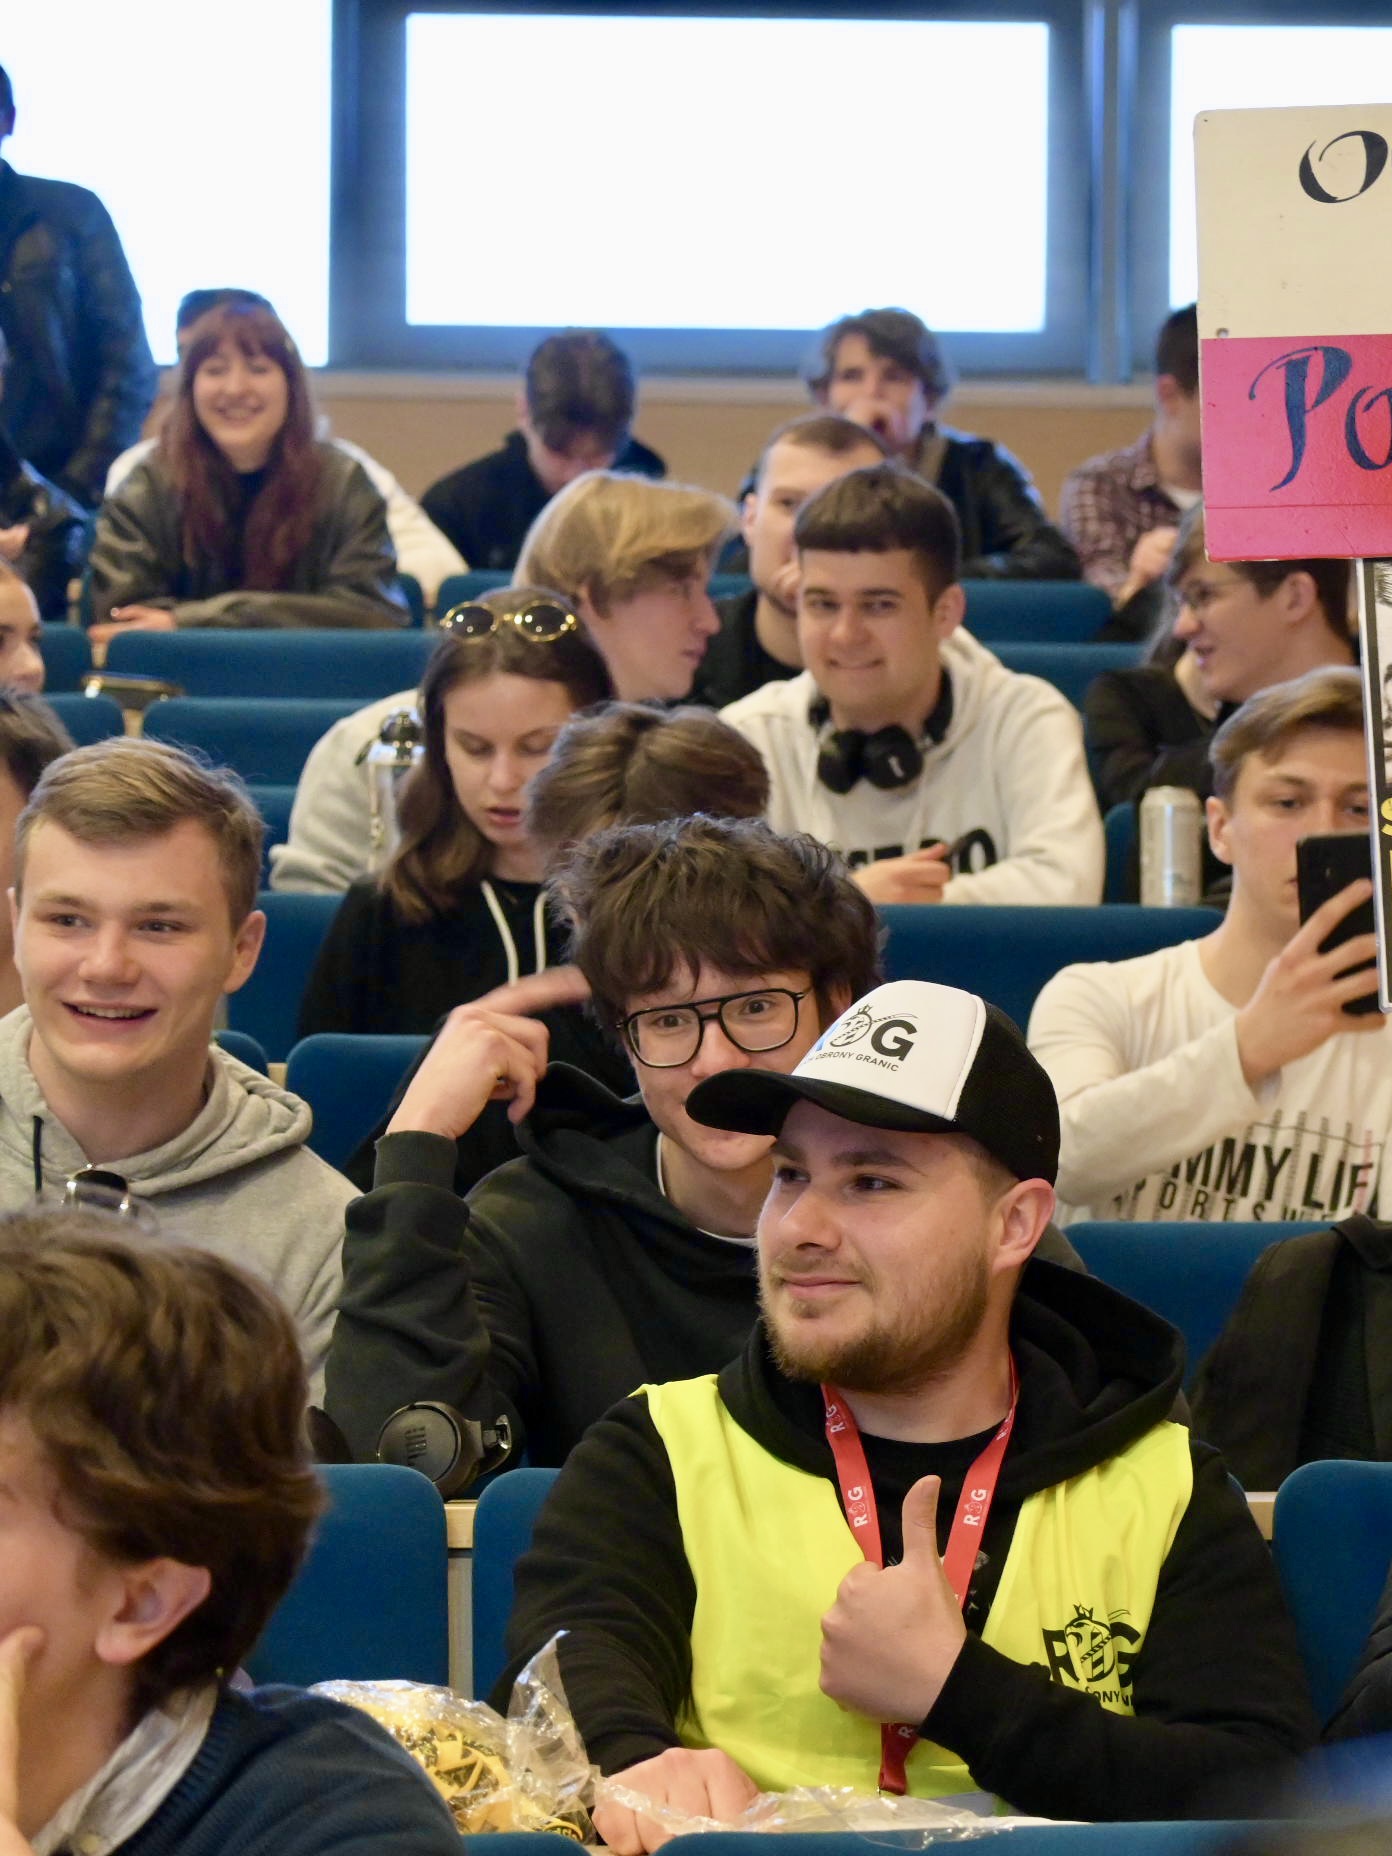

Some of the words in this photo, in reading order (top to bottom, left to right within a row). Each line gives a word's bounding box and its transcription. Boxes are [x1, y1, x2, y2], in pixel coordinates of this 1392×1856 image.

[855, 1053, 900, 1072] GRANIC
[1171, 1137, 1293, 1201] MMY
[1302, 1152, 1377, 1217] LIF
